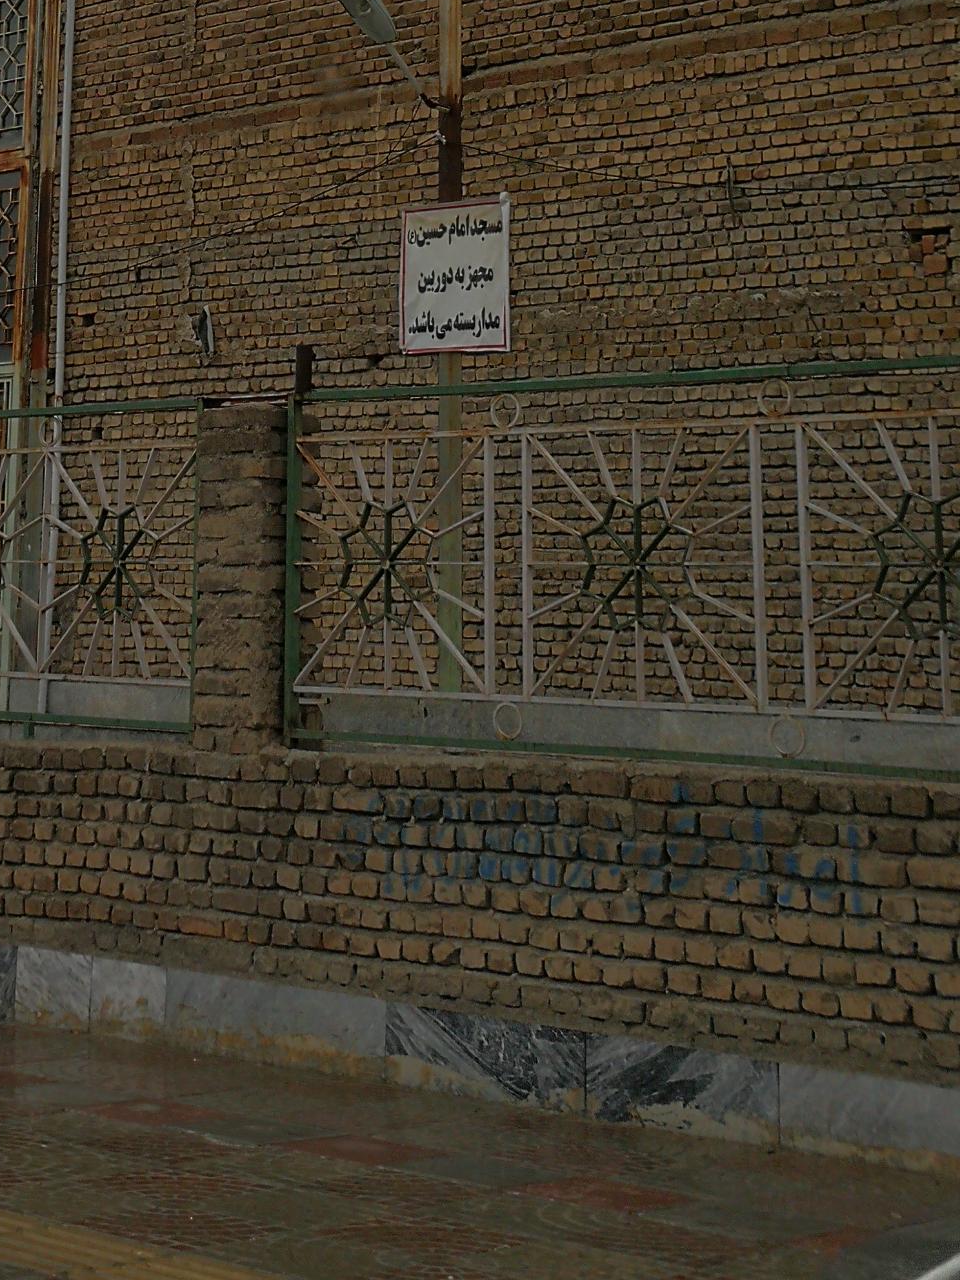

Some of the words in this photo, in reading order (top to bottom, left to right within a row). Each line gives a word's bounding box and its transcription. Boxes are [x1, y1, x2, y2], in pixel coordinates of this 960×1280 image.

[448, 213, 470, 246] امام
[470, 218, 503, 241] مسجد
[418, 266, 454, 294] دوربین
[454, 266, 465, 290] به
[465, 265, 494, 291] مجهز
[474, 306, 500, 338] مدار
